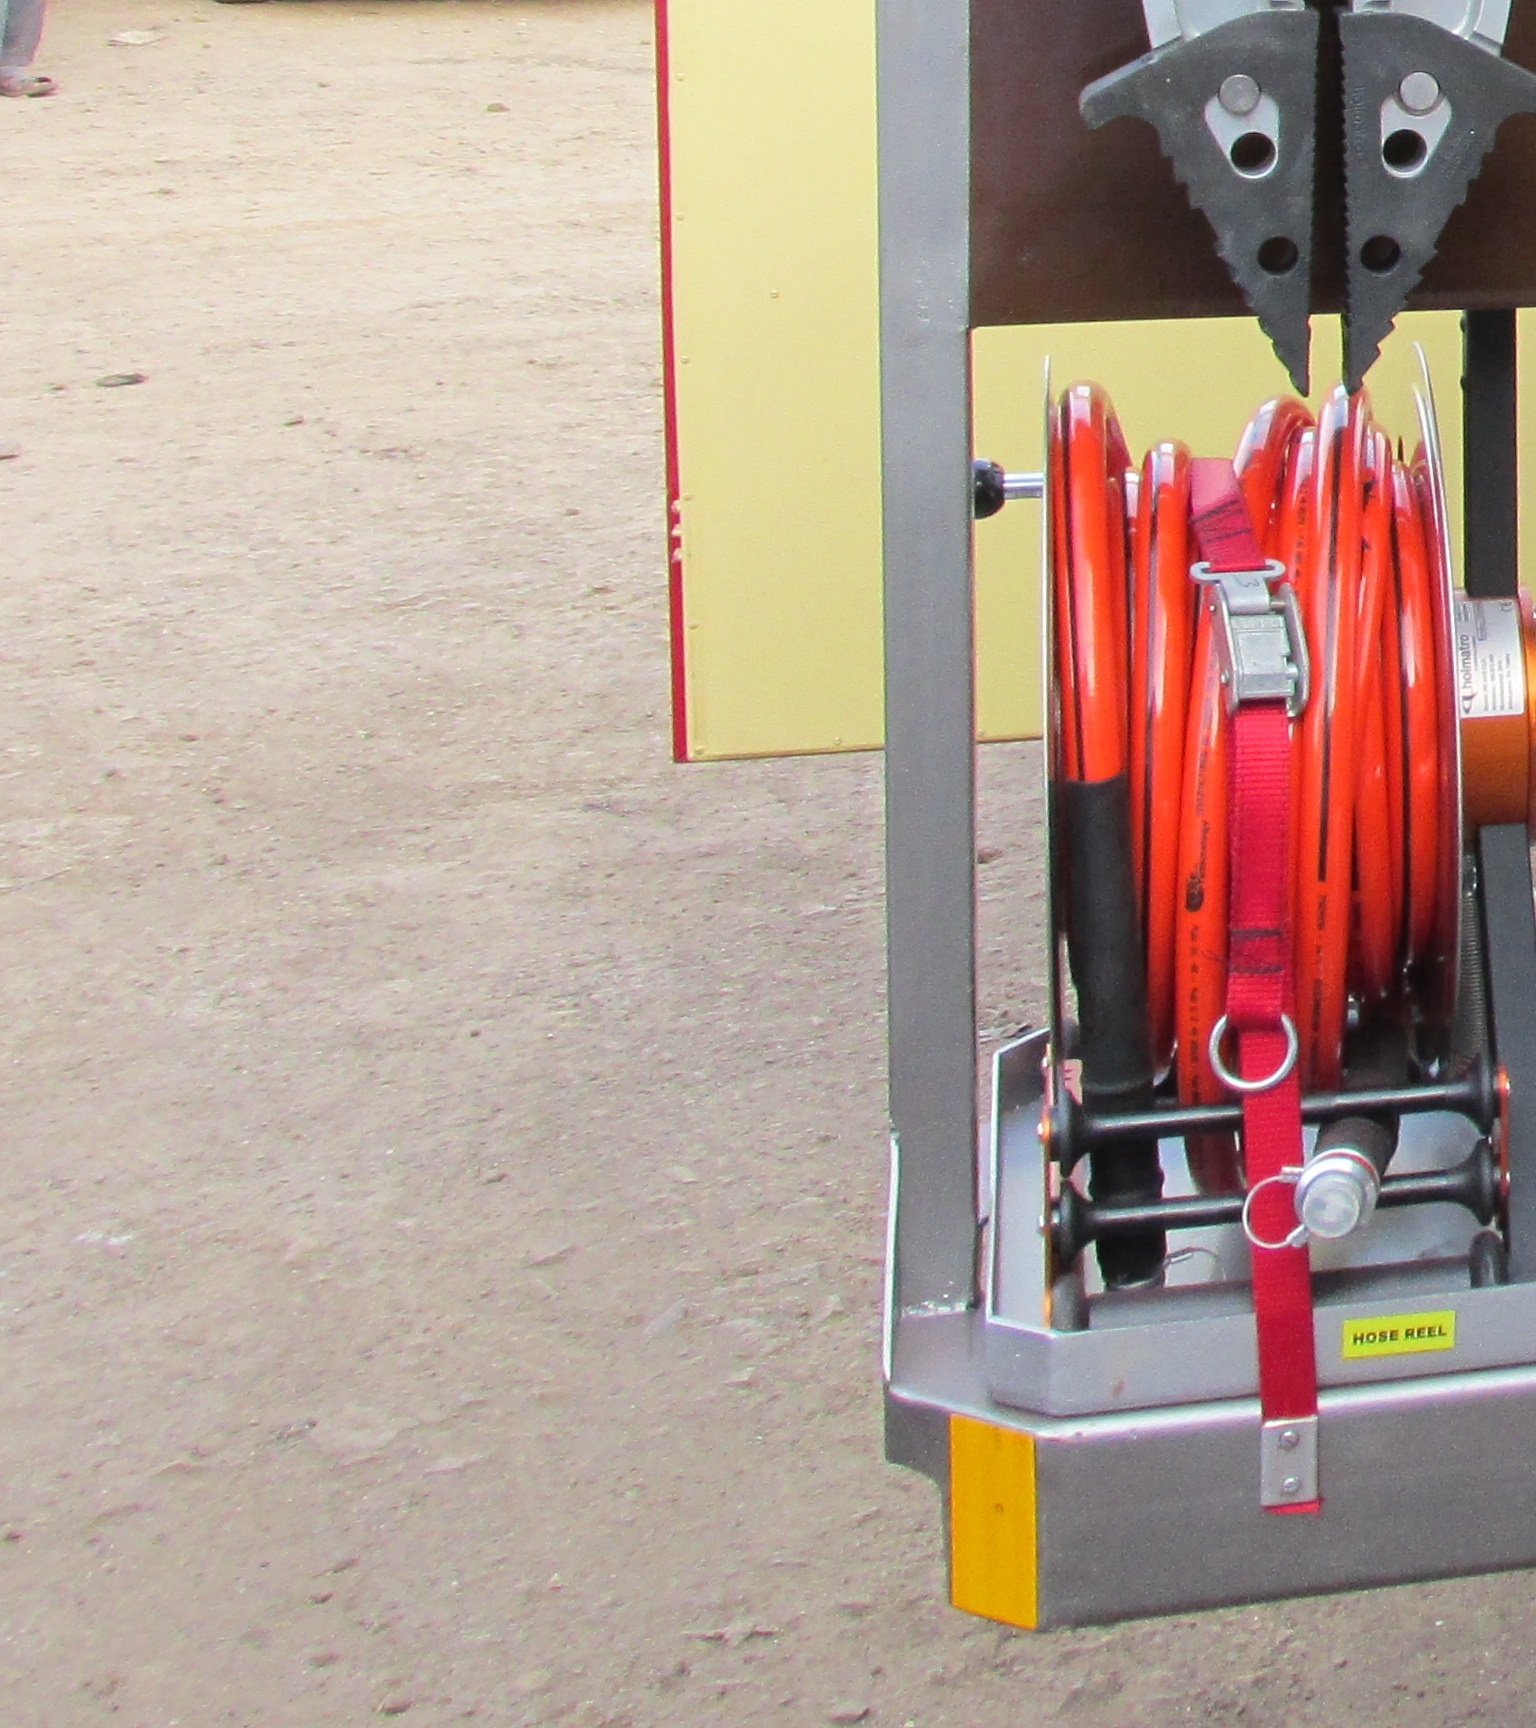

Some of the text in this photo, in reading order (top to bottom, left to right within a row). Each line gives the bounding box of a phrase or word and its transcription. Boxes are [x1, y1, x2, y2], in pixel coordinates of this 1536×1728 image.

[1459, 634, 1473, 690] holmatro
[1352, 1324, 1448, 1345] HOSE REEL
